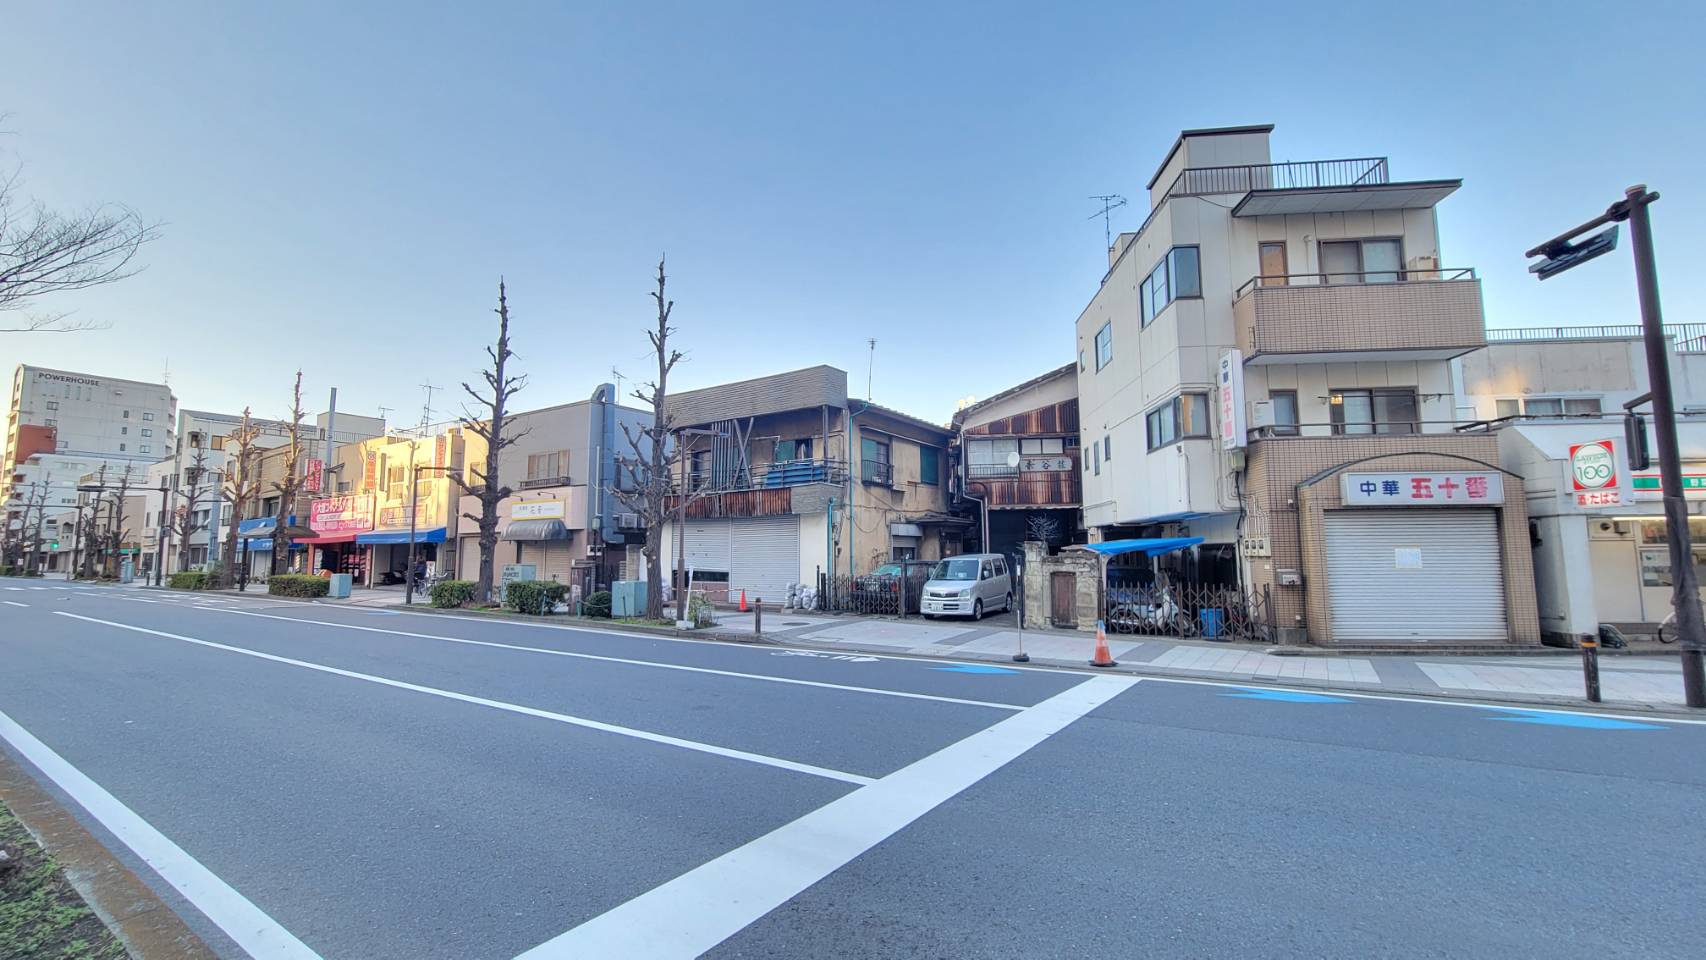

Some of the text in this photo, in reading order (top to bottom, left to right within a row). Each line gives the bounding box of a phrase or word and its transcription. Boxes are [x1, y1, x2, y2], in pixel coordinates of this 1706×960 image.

[38, 372, 100, 386] POWERHOUSE
[1360, 476, 1489, 499] 中華 五十番
